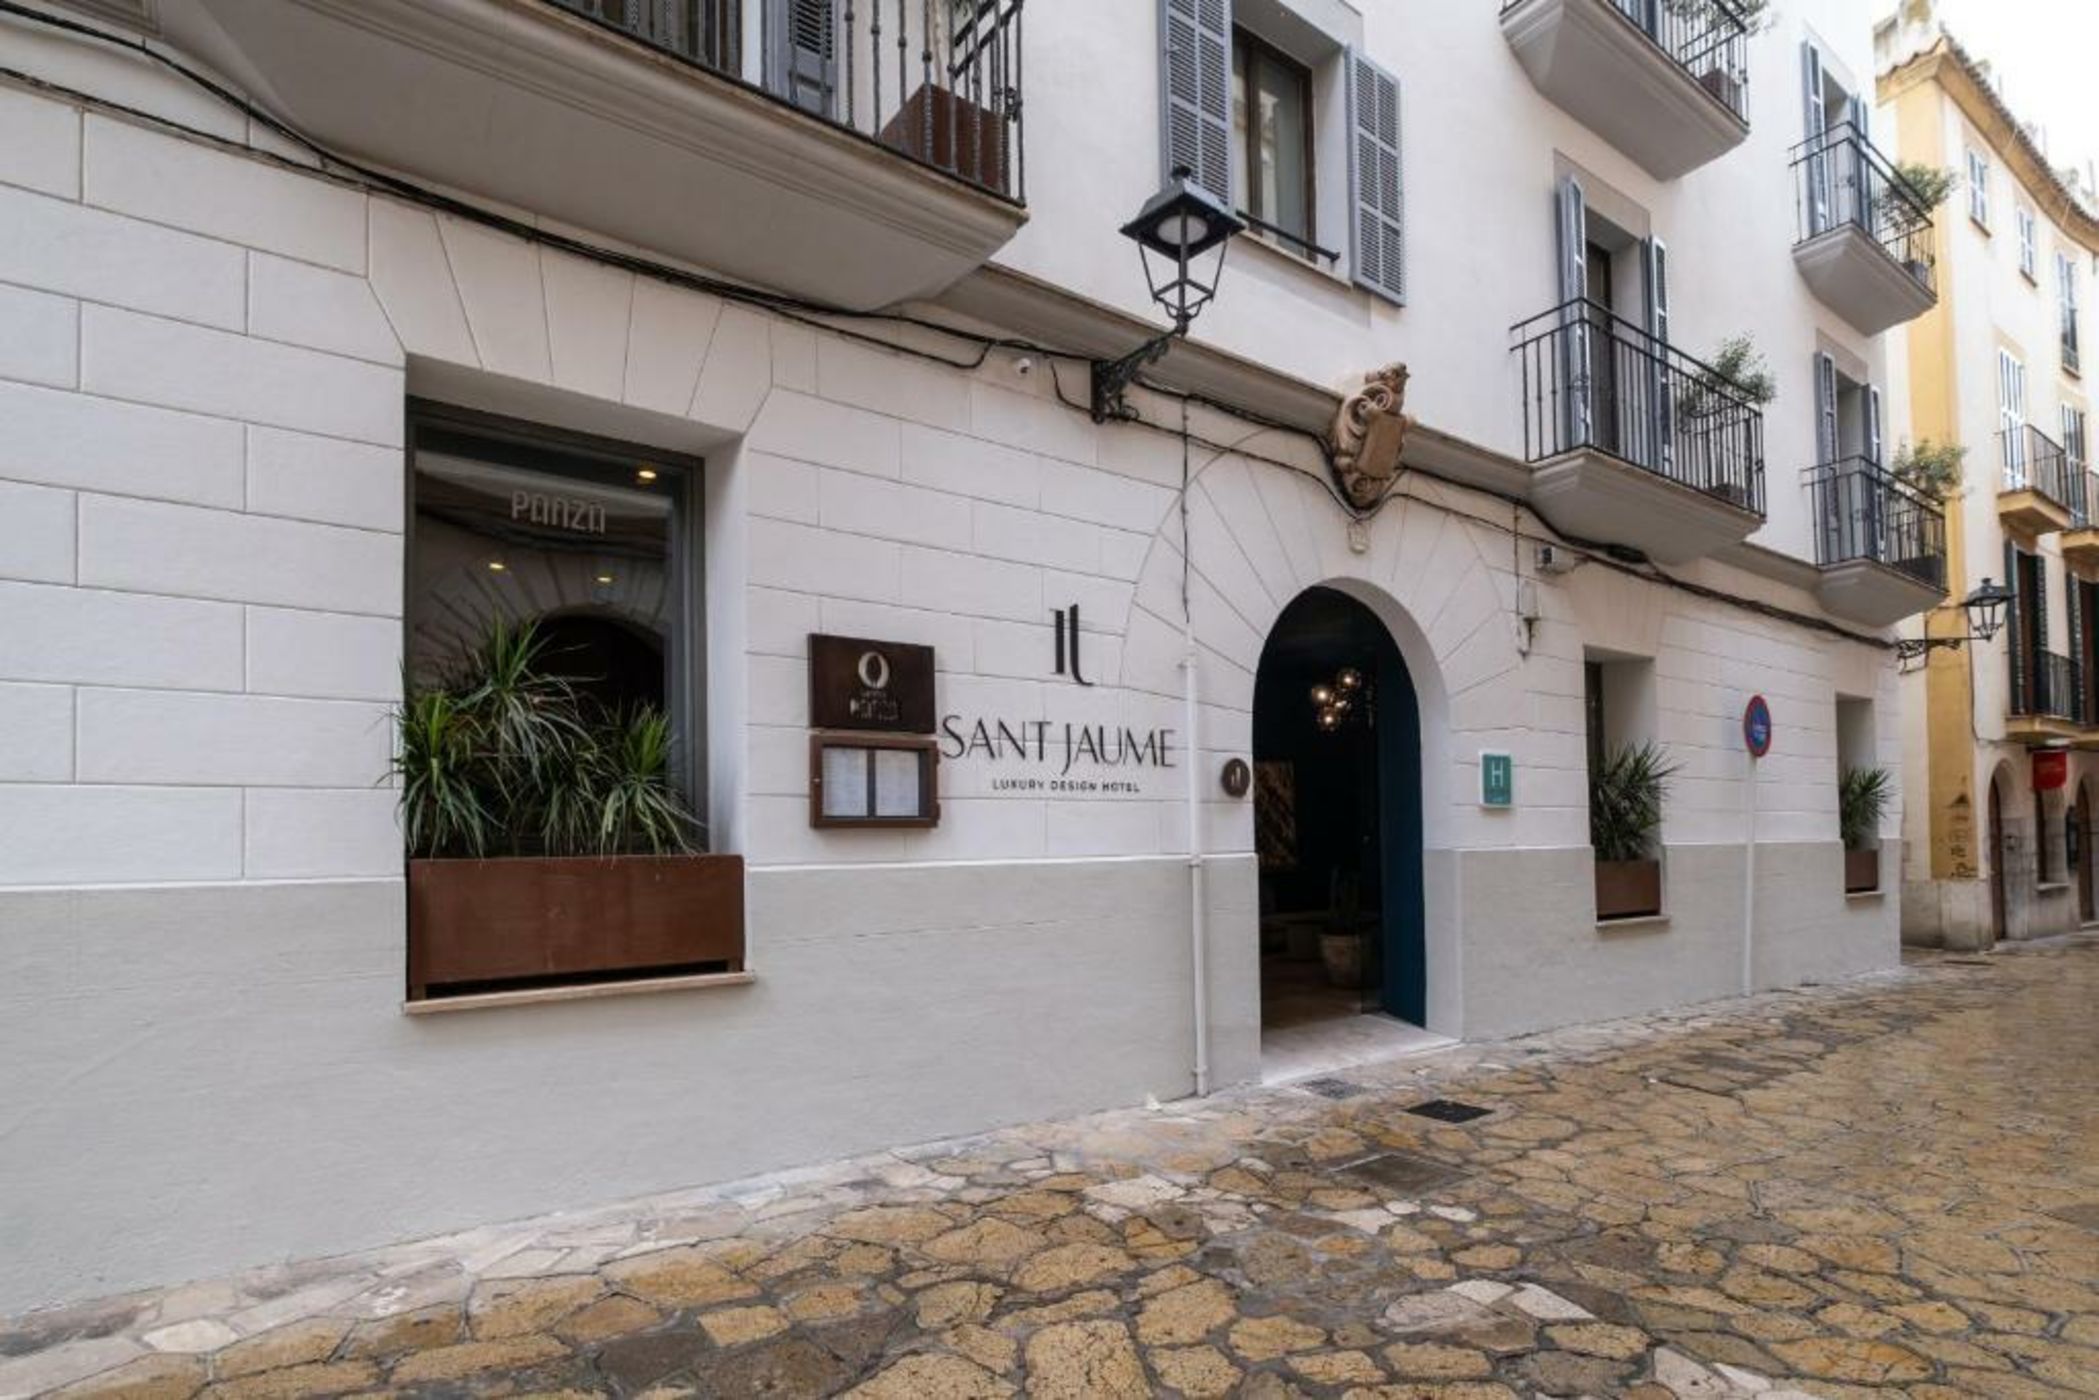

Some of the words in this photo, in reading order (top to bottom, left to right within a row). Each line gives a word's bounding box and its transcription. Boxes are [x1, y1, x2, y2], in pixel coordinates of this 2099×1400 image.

[942, 714, 1053, 762] SANT
[1061, 722, 1177, 776] JAUME
[992, 778, 1044, 791] LUXURY
[1050, 779, 1098, 792] DESIGN
[1102, 780, 1141, 793] HOTEL
[1491, 759, 1504, 788] H
